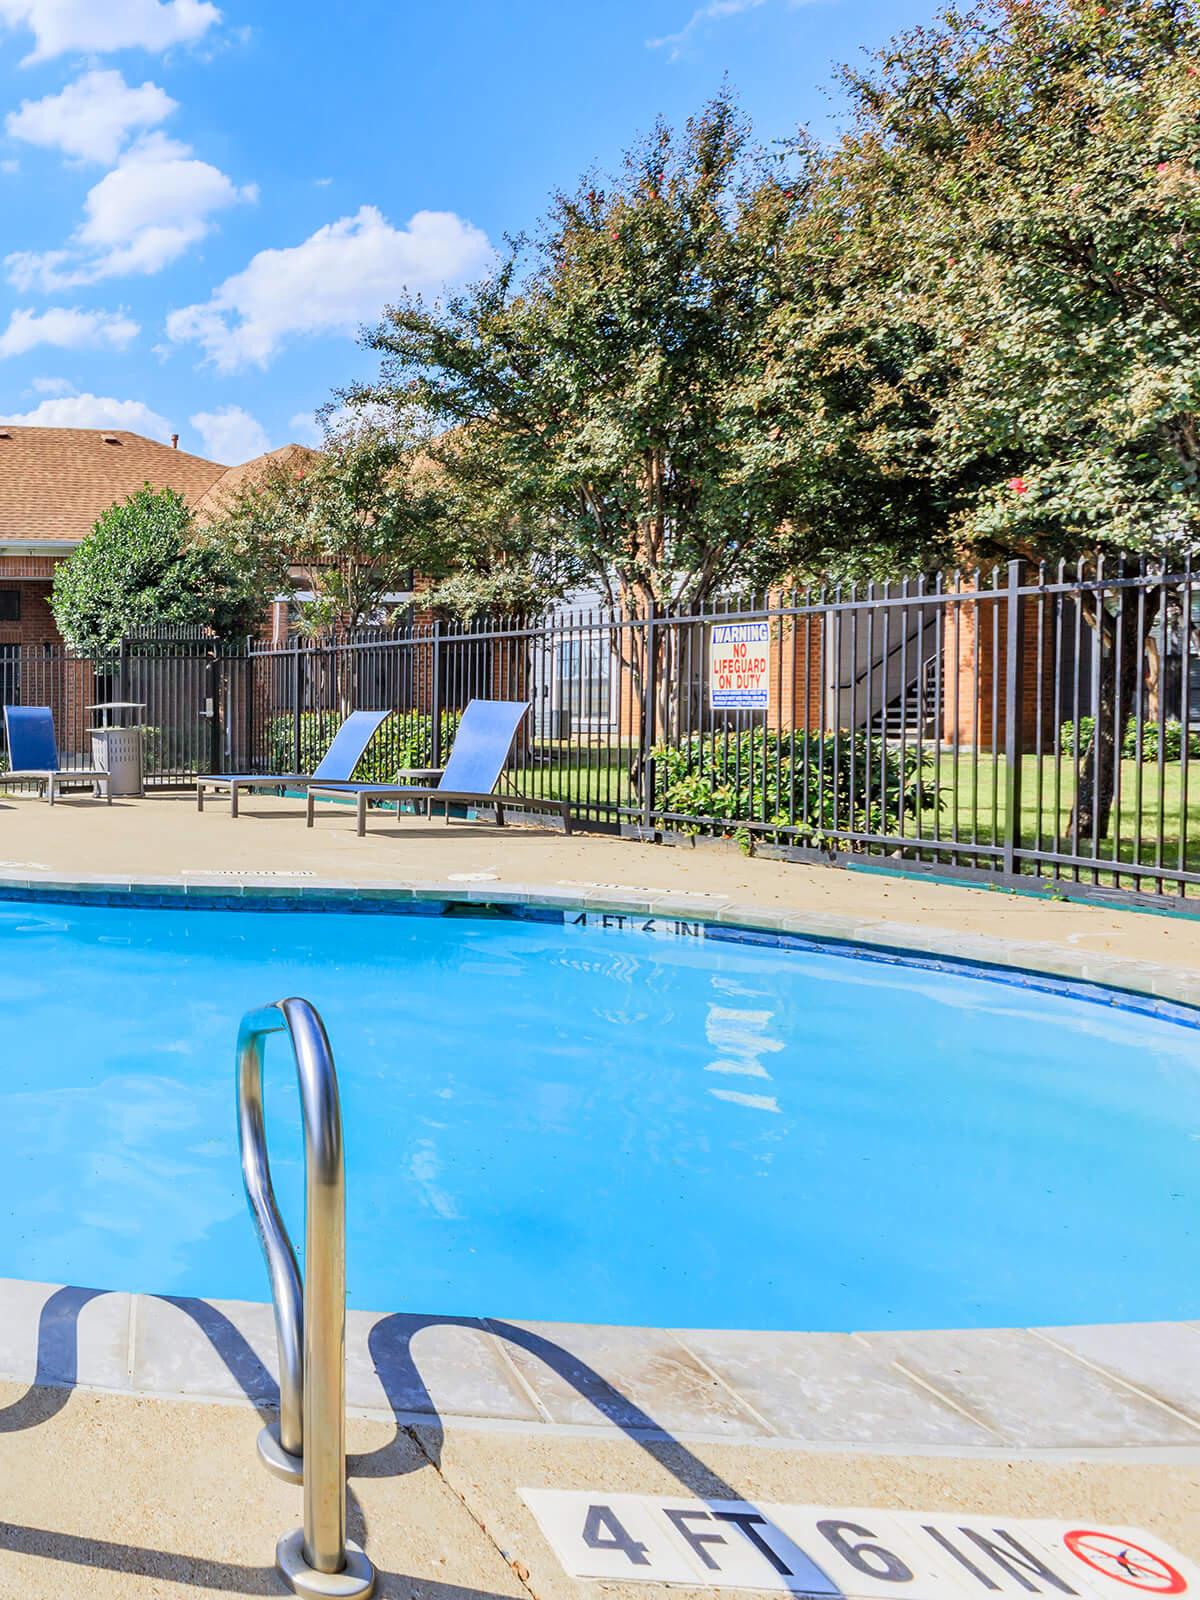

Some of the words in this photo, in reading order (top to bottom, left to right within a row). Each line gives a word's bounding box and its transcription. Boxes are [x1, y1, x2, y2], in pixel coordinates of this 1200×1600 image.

[715, 625, 767, 643] WARNING
[733, 643, 747, 658] NO
[714, 659, 766, 673] LIFEGUARD
[719, 675, 732, 689] ON
[736, 674, 761, 689] DUTY
[602, 914, 627, 930] FT
[675, 921, 700, 938] IN
[582, 1504, 653, 1567] 4
[661, 1508, 796, 1577] FT
[815, 1519, 916, 1583] 6
[920, 1524, 1083, 1598] IN
